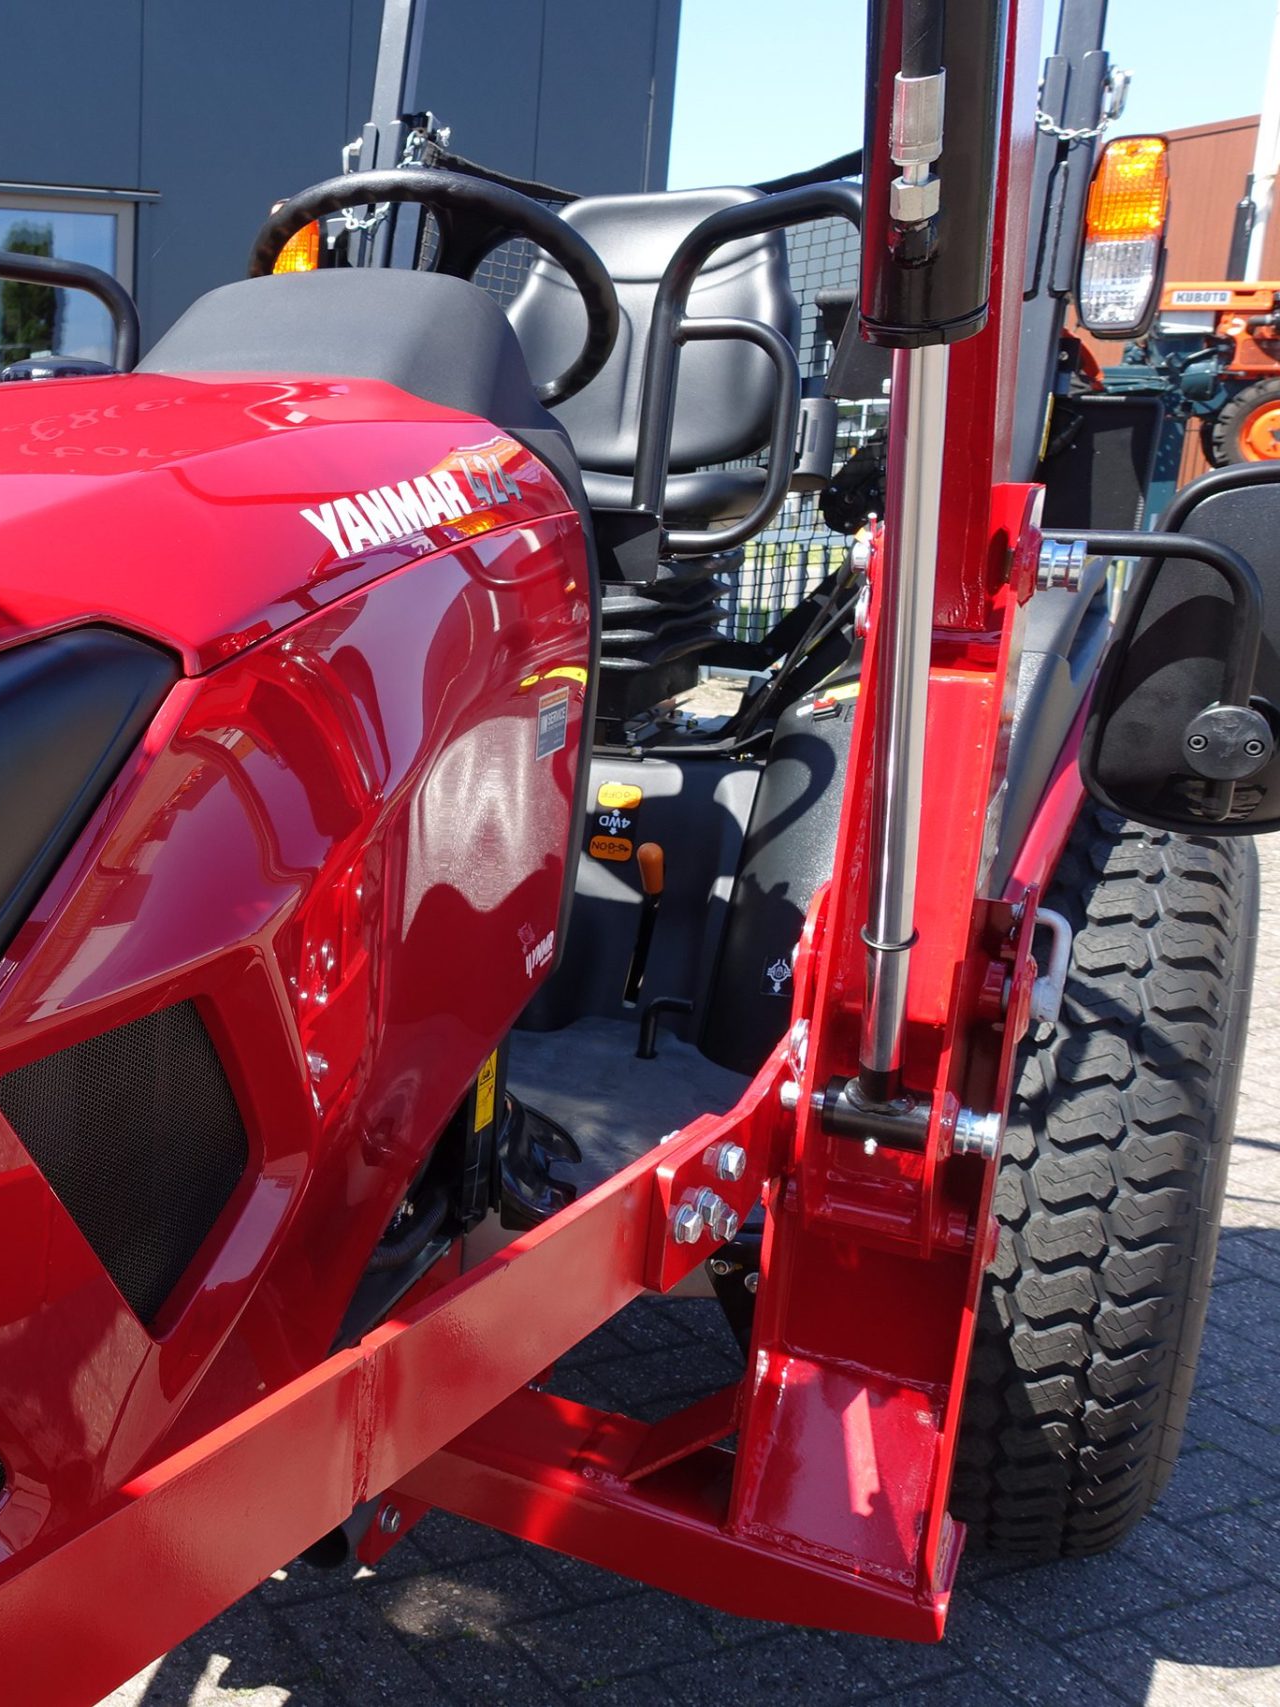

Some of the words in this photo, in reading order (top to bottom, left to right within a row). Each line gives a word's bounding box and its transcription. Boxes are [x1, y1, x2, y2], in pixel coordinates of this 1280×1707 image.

[1176, 292, 1228, 303] KUBOTA
[299, 470, 473, 559] YANMAR
[458, 453, 523, 506] 424
[599, 814, 632, 828] 4WD
[592, 841, 607, 851] ON
